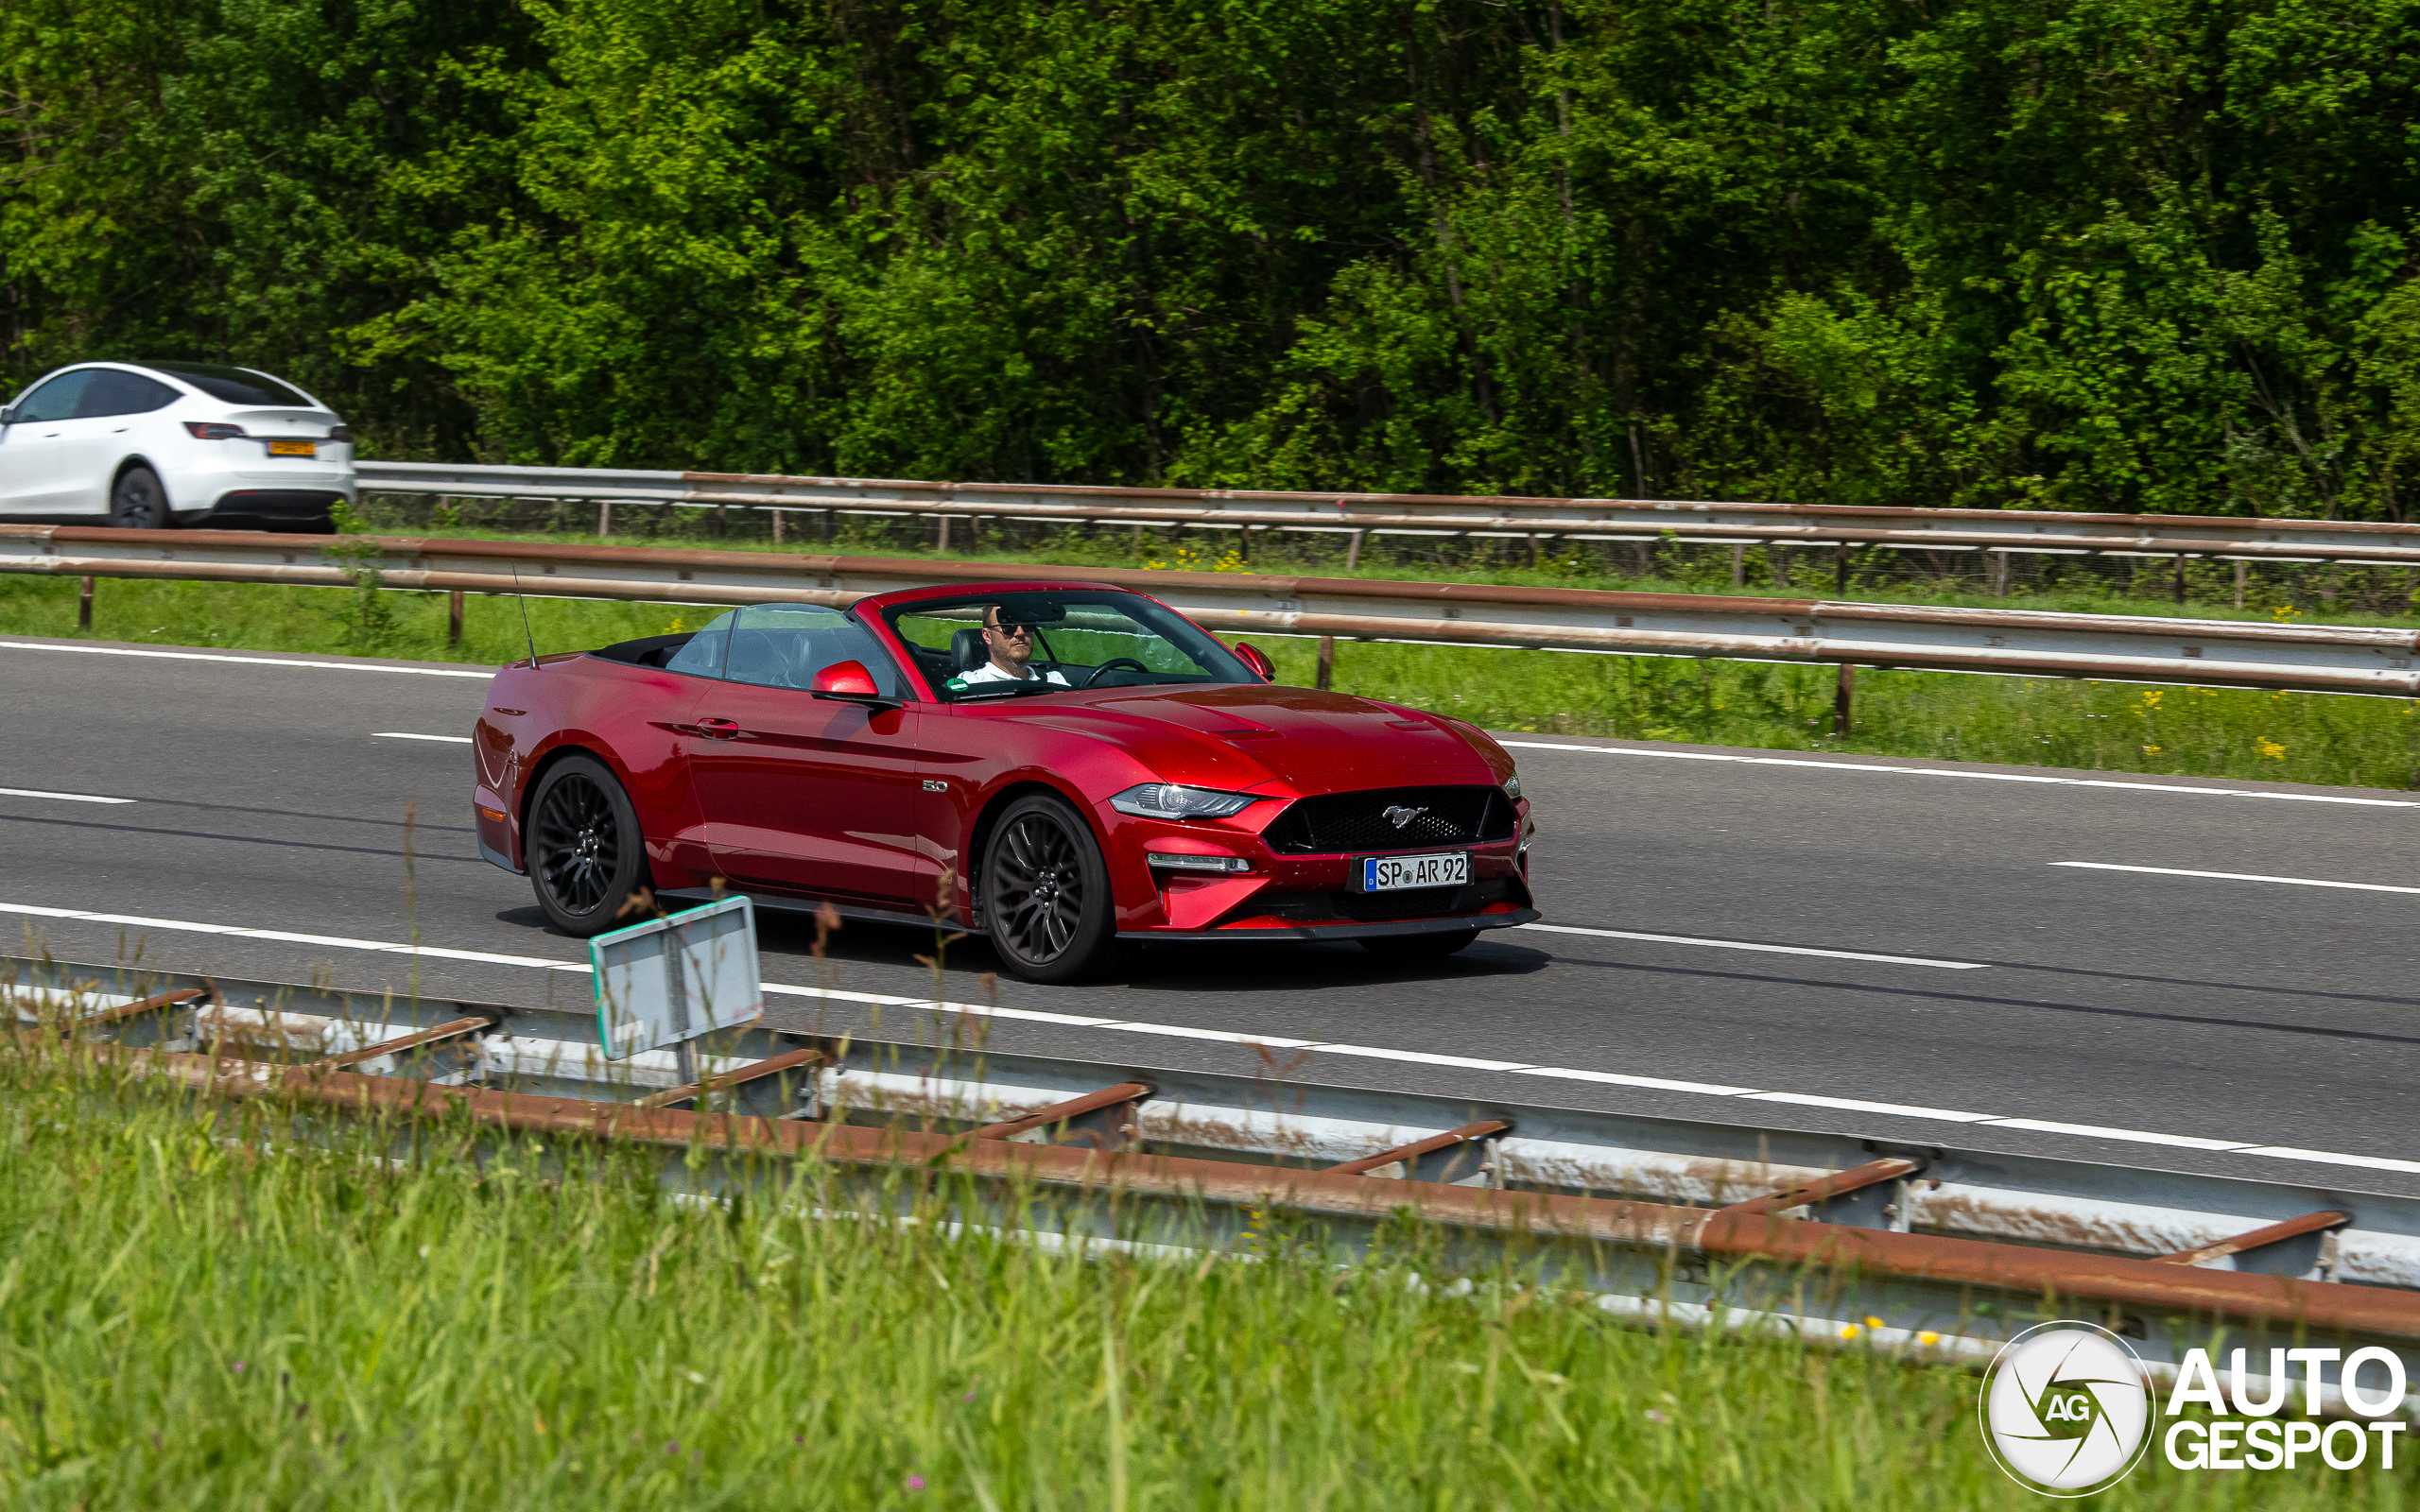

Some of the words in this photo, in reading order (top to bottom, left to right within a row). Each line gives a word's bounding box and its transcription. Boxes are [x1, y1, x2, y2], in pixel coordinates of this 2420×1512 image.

[1377, 862, 1402, 885] SP
[1416, 860, 1439, 884] AR
[1443, 858, 1465, 881] 92
